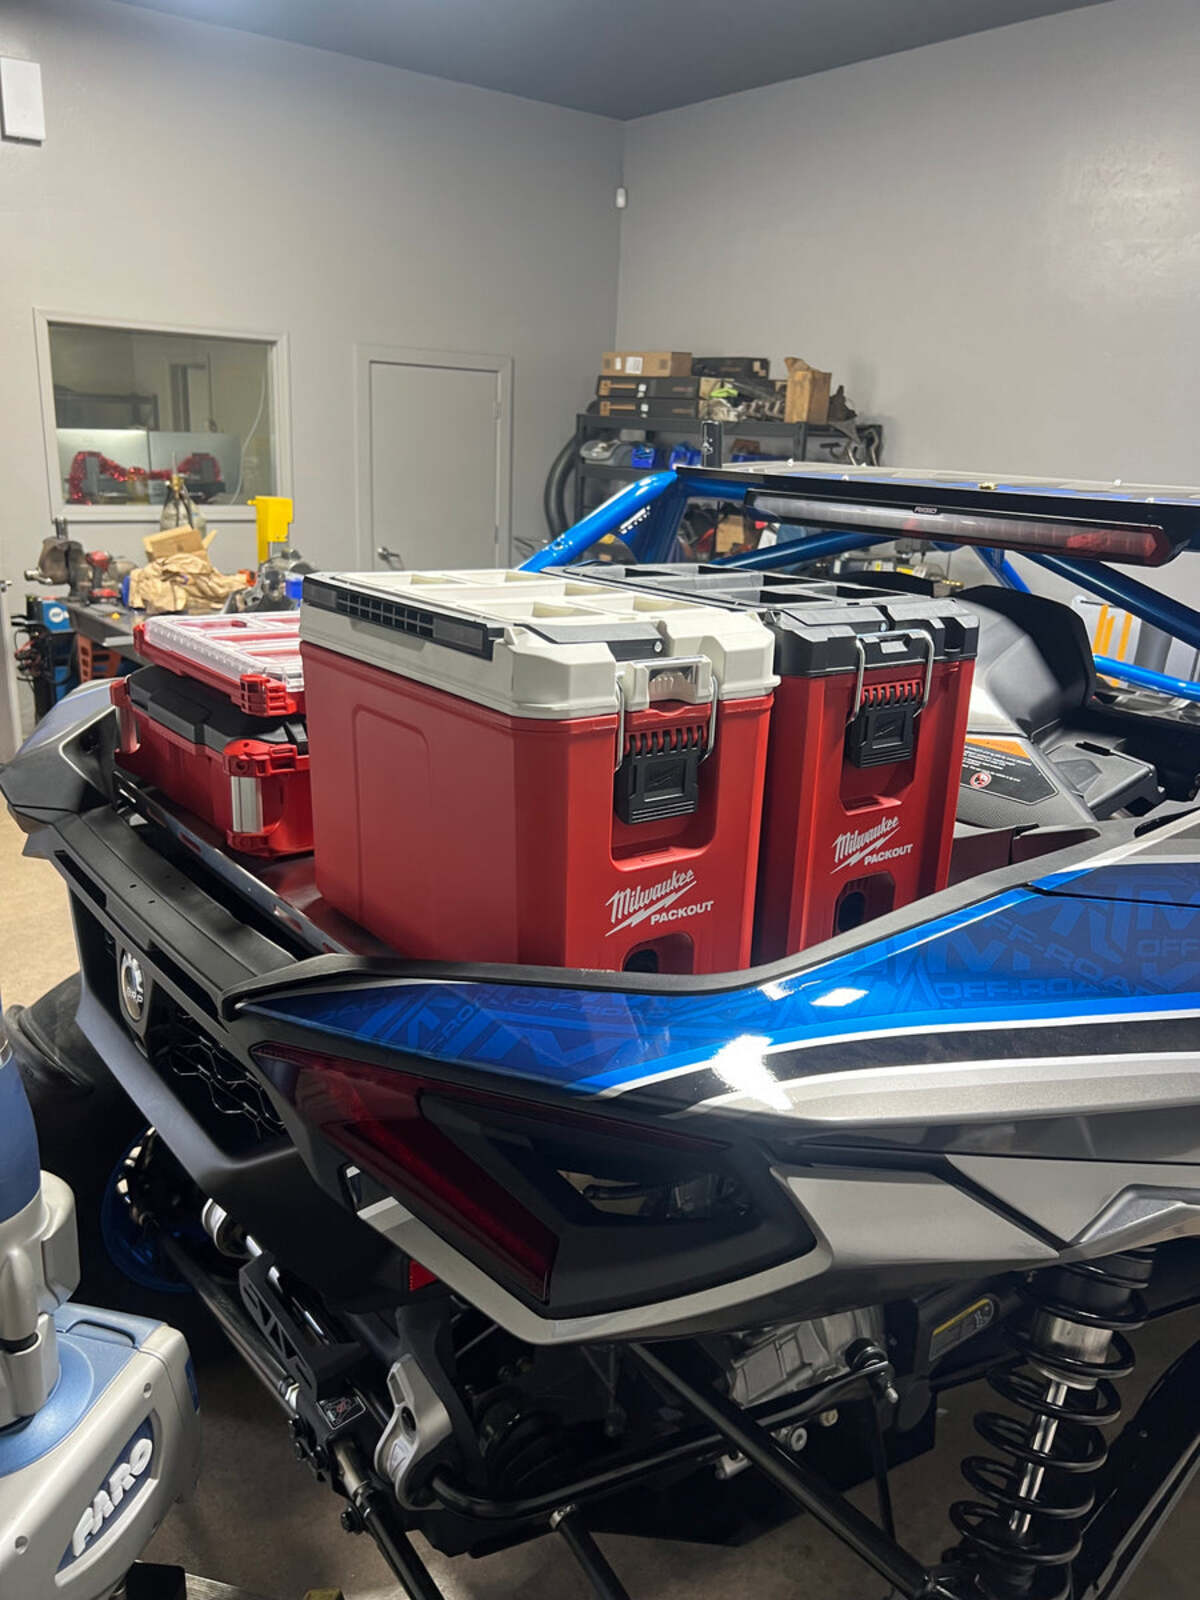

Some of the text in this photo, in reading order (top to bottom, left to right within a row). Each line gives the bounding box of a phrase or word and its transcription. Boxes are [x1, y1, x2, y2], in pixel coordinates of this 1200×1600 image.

[831, 816, 899, 863] Milwaukee
[863, 843, 913, 866] PACKOUT
[605, 869, 695, 924] Milwaukee
[650, 900, 714, 925] PACKOUT
[73, 1438, 153, 1557] FARO
